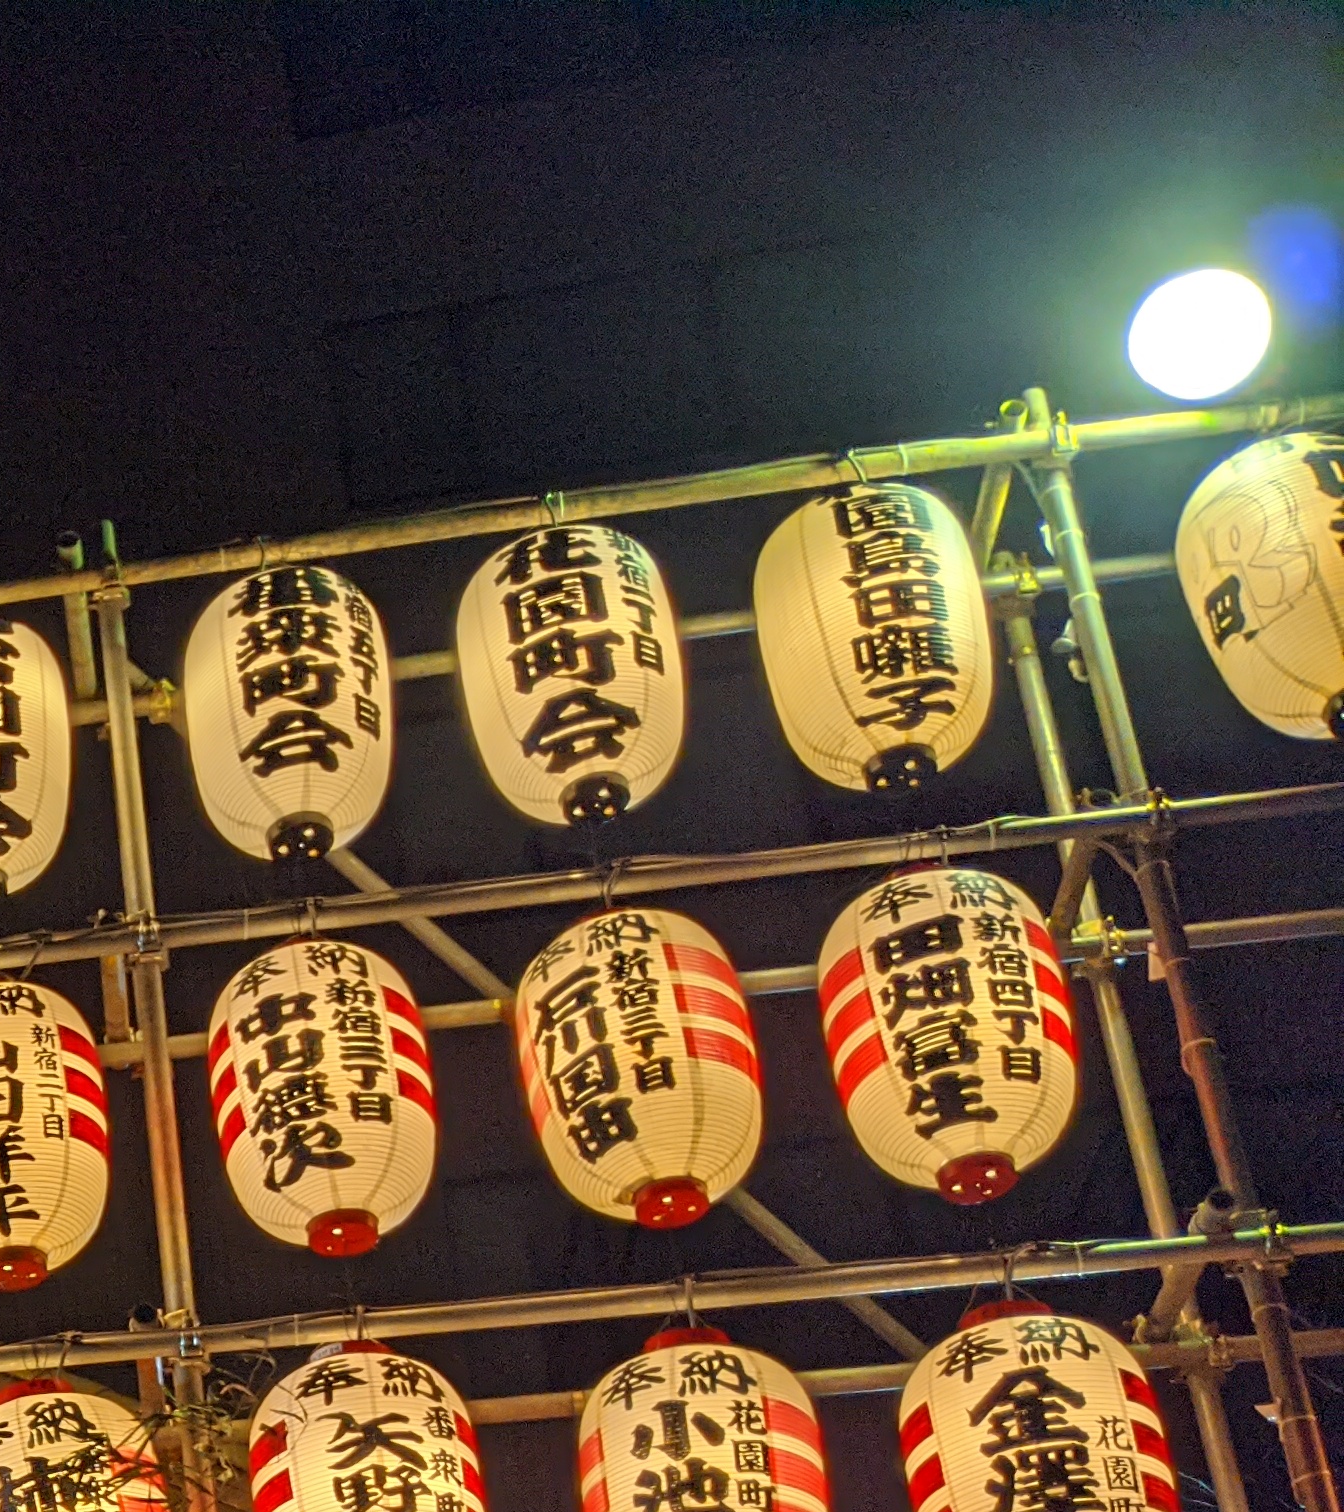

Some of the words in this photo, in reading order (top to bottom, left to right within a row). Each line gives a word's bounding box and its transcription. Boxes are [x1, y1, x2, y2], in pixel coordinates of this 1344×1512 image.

[817, 487, 960, 731] 園島田囃子
[861, 870, 1019, 925] 奉納
[230, 942, 369, 999] 奉納
[526, 911, 661, 984] 奉納
[603, 947, 678, 1096] 新宿三丁目
[868, 913, 1000, 1141] 田畑富生
[971, 911, 1044, 1086] 新宿四丁目
[27, 1022, 67, 1142] 新宿二丁目
[322, 976, 395, 1127] 新宿三丁目
[294, 1356, 448, 1406] 奉納
[600, 1350, 758, 1411] 奉納
[936, 1316, 1102, 1384] 奉納
